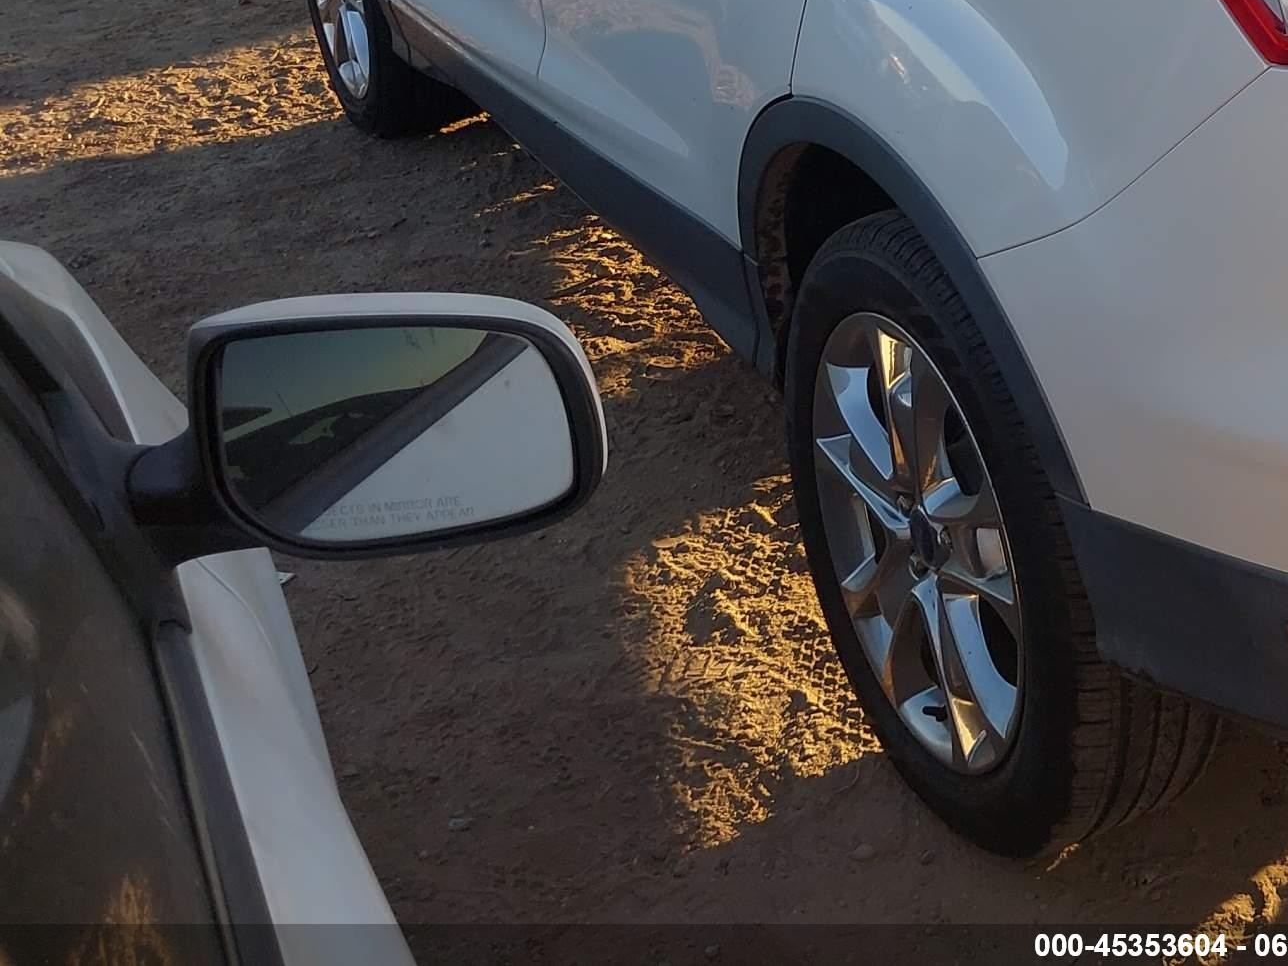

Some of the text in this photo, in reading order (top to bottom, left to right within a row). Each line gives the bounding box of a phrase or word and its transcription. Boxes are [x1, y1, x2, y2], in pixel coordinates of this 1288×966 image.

[384, 498, 433, 512] MIRROR
[437, 496, 460, 507] ARE
[353, 514, 386, 527] THAN
[390, 511, 420, 524] THEY
[426, 506, 475, 521] APPEAR
